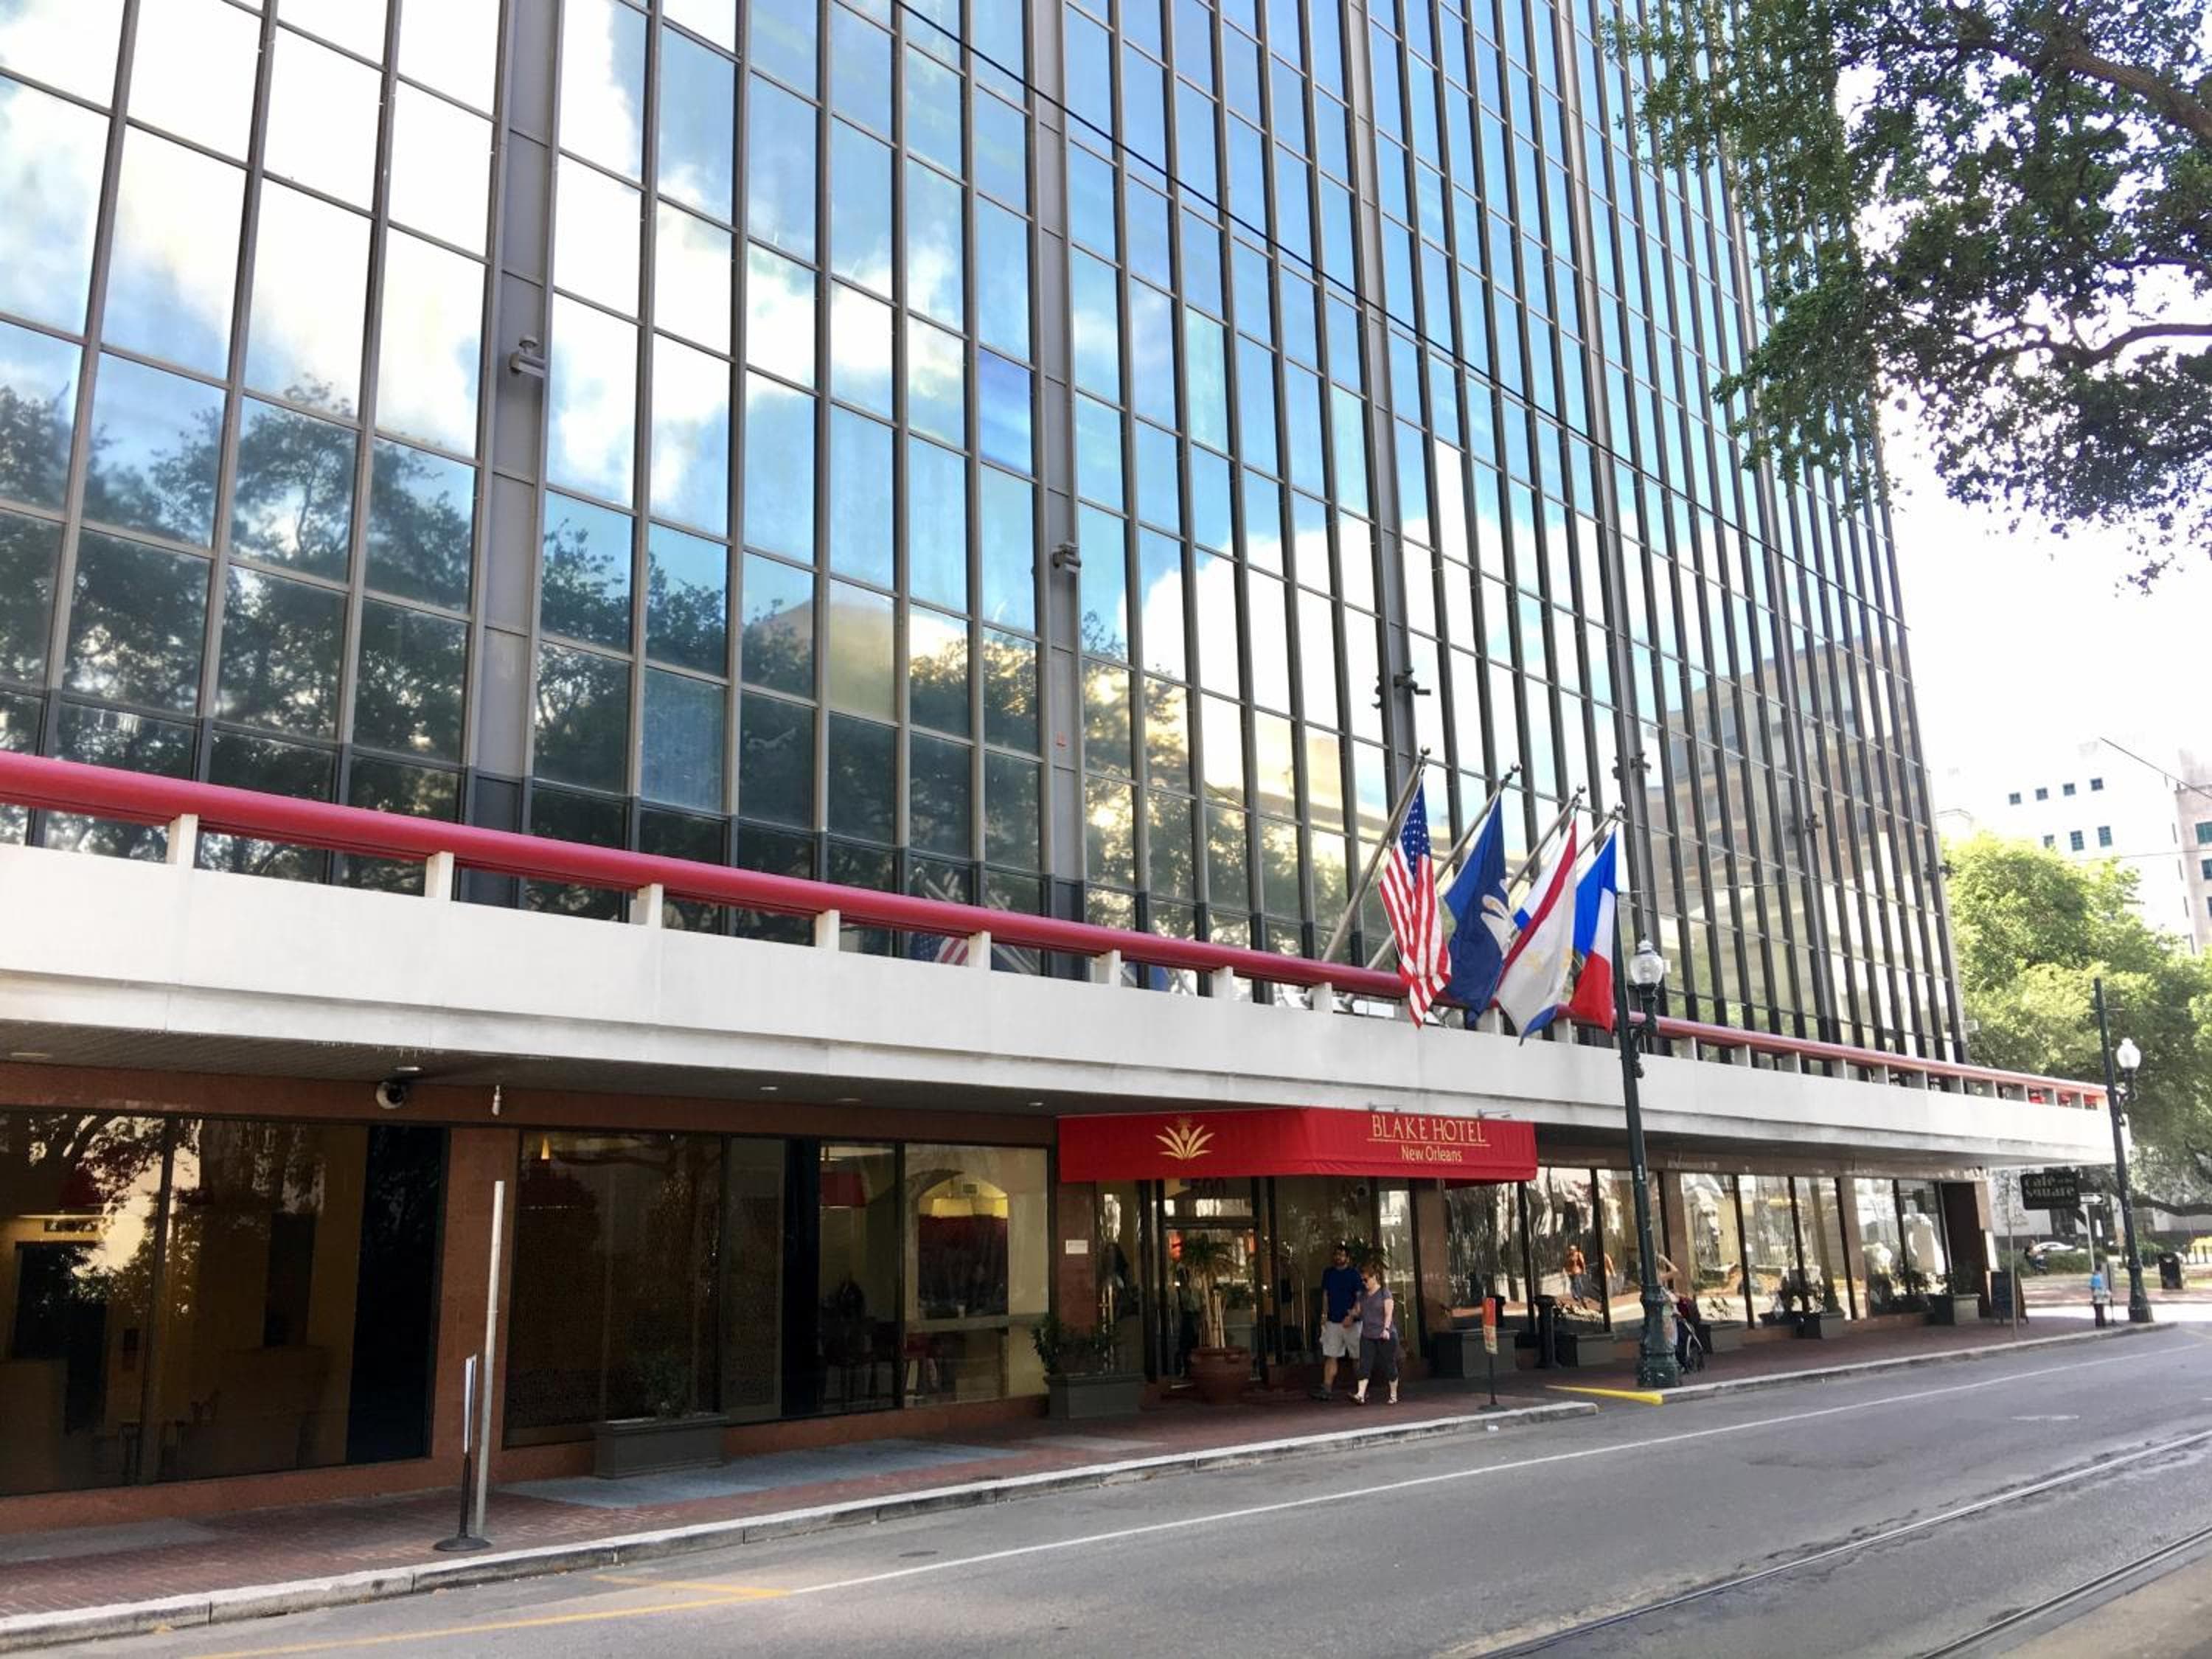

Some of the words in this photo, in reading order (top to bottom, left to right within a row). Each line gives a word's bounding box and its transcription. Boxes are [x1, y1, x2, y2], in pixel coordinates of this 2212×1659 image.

[1372, 1114, 1428, 1140] BLAKE
[1431, 1119, 1486, 1143] HOTEL
[1402, 1144, 1424, 1161] New
[1425, 1145, 1462, 1163] Orleans
